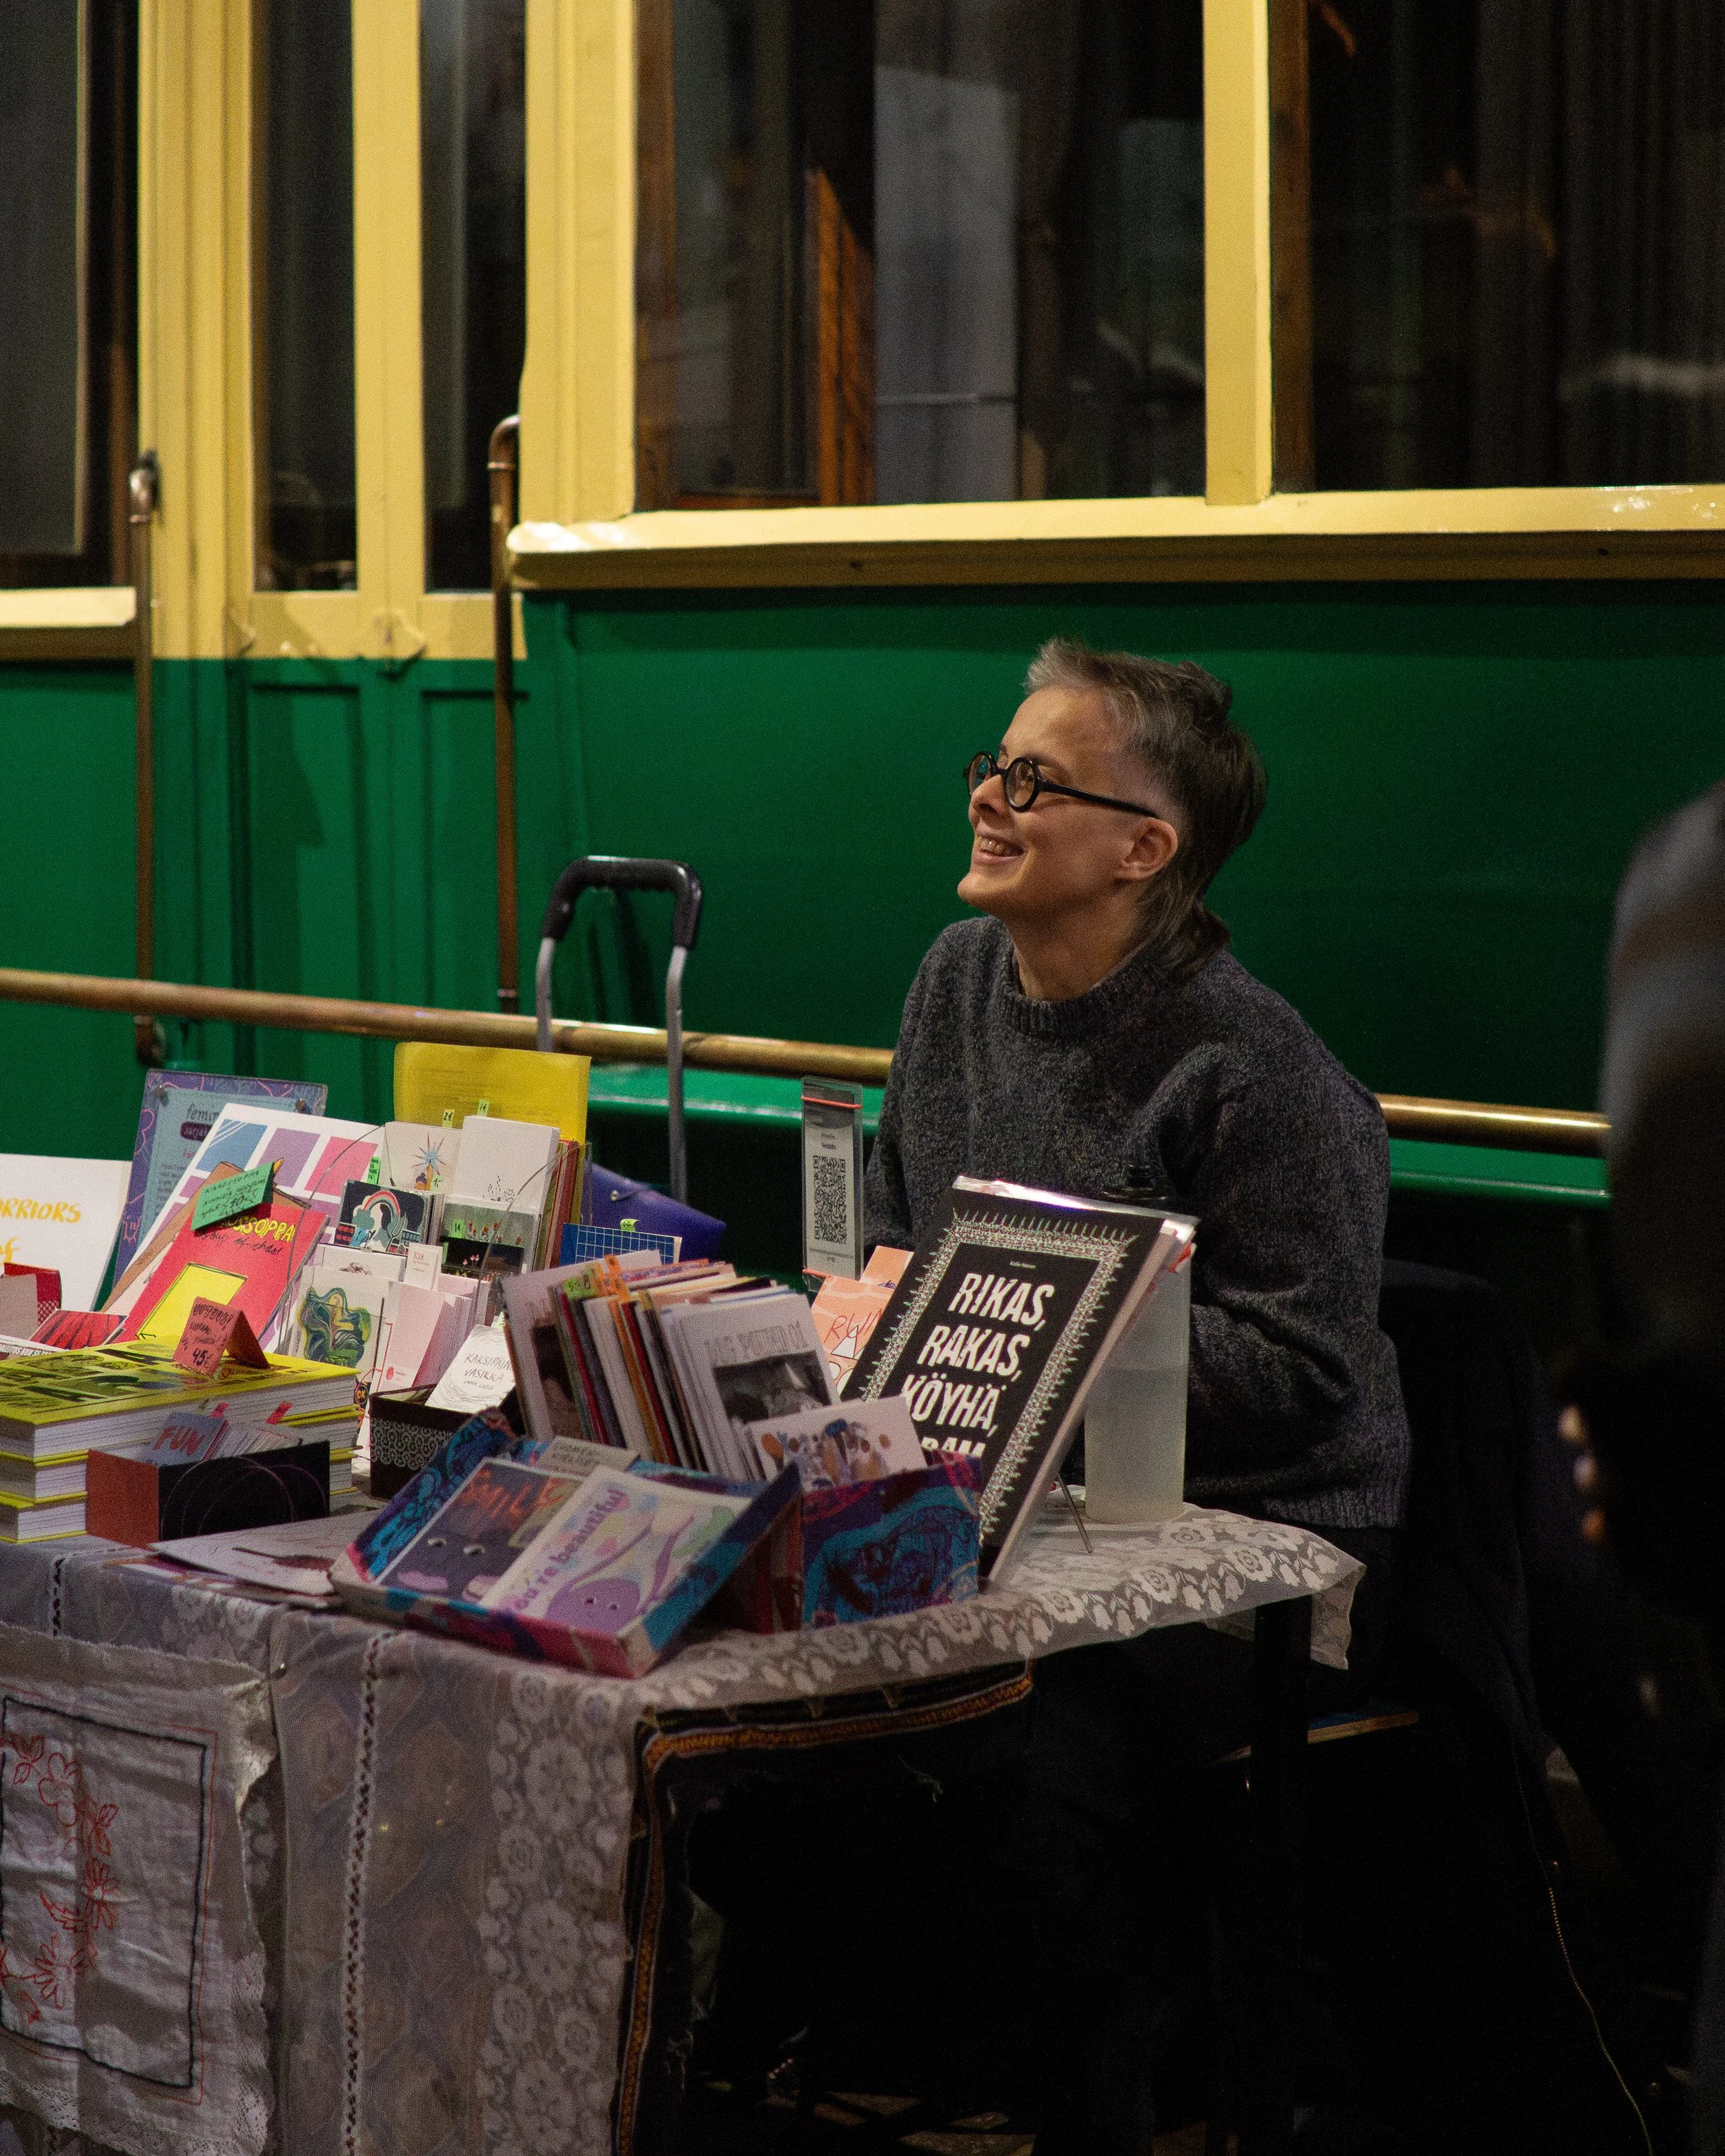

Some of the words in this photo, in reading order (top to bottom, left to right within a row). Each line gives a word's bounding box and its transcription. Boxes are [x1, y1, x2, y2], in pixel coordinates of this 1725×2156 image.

[443, 1111, 453, 1122] 2€
[0, 1197, 81, 1223] RRIORS
[947, 1272, 1055, 1332] RIKAS,
[464, 1352, 513, 1370] KAKSIPÄIN
[916, 1324, 1031, 1382] RAKAS,
[464, 1368, 504, 1383] VASIKKA
[901, 1372, 1007, 1438] KÖYHÄ,
[152, 1425, 206, 1457] FUN
